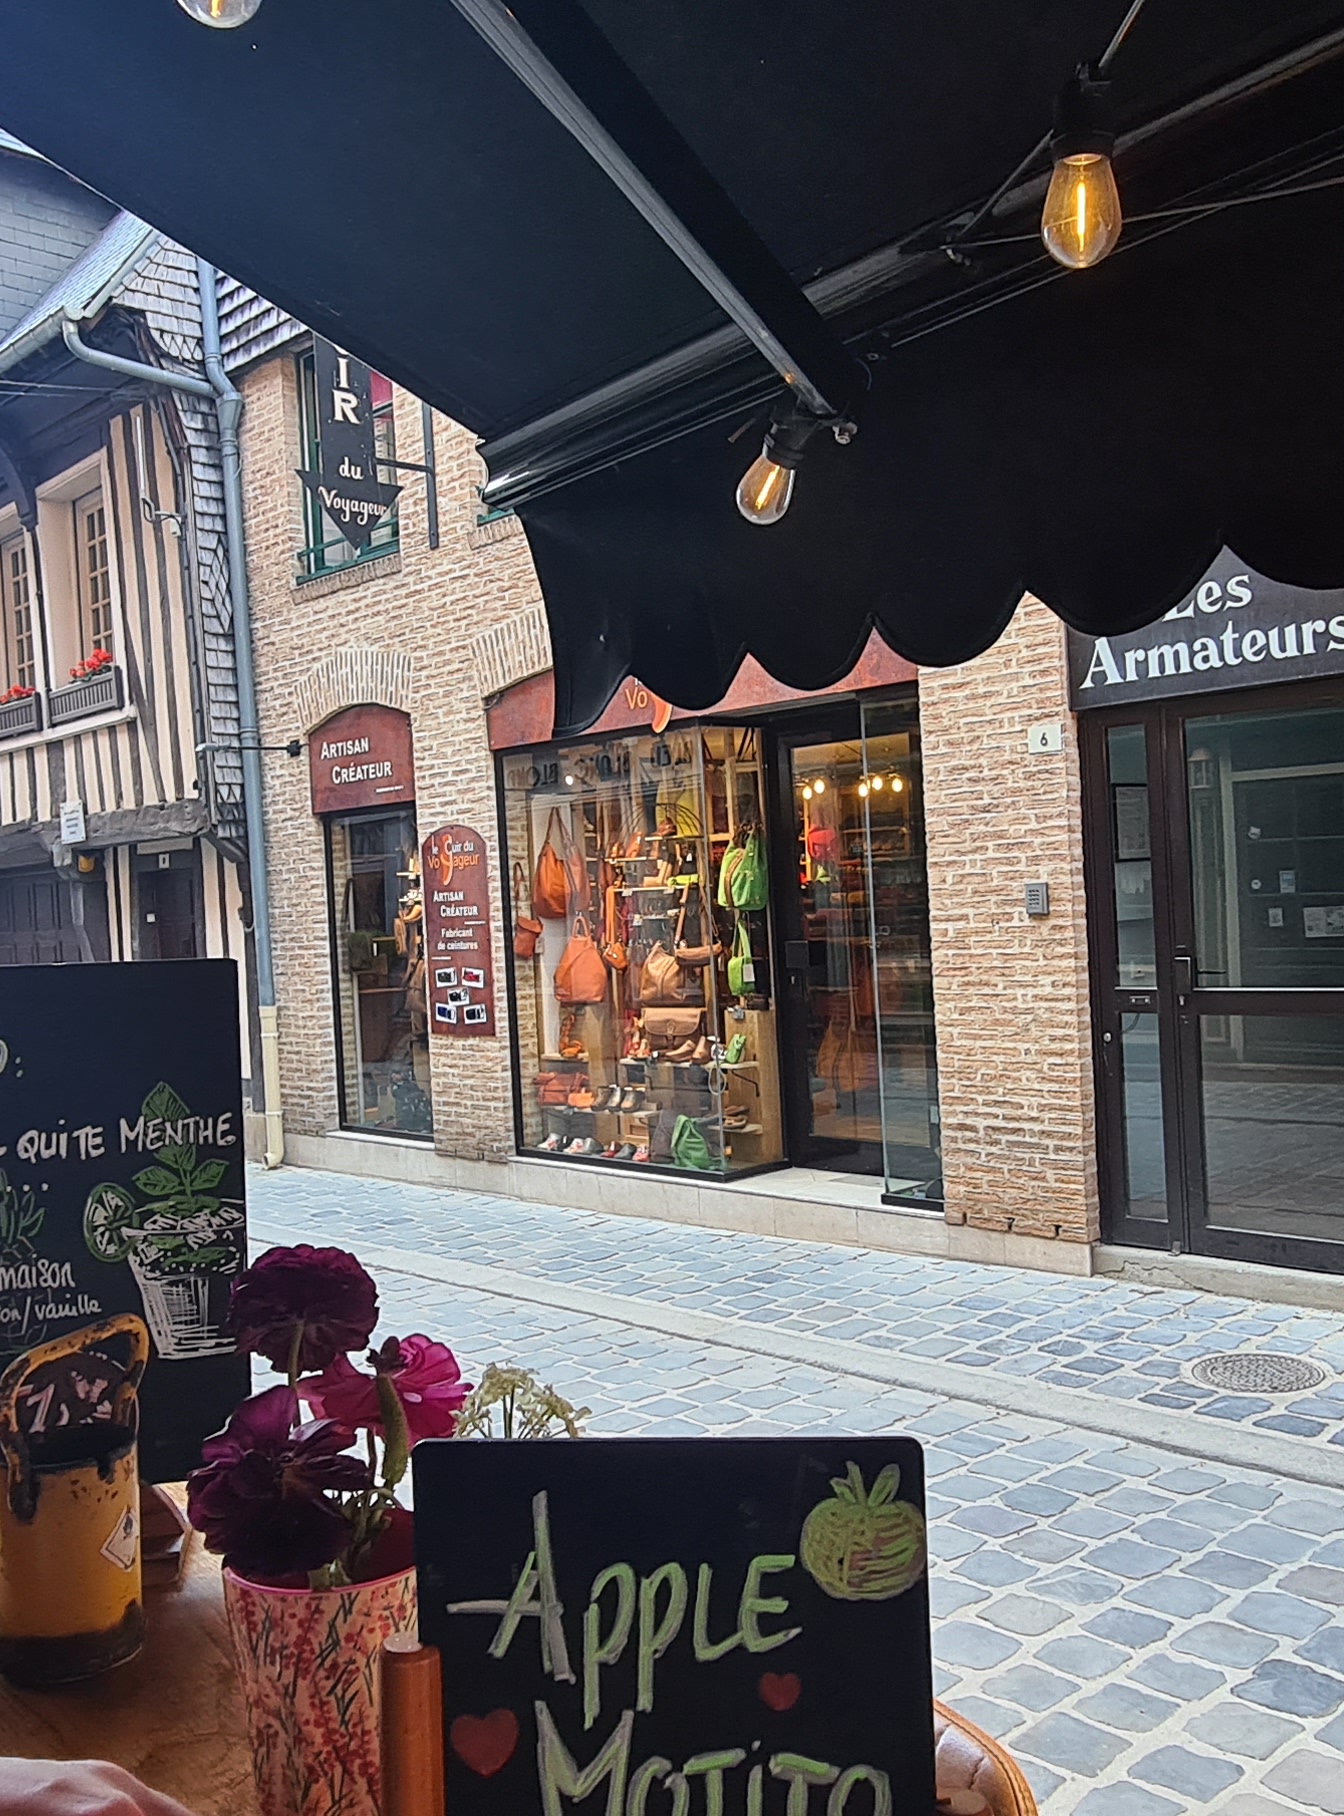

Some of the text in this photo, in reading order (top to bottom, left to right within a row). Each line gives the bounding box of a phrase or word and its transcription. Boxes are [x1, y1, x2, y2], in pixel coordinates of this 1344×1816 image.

[339, 457, 363, 479] du
[318, 486, 386, 525] Voyageur
[1162, 574, 1253, 622] Les
[320, 737, 369, 760] ARTISAN
[1040, 732, 1048, 746] 6
[332, 761, 392, 785] CRÉATEUR
[463, 841, 474, 852] du
[433, 890, 464, 902] ARTISAN
[119, 1112, 236, 1157] MENTHE
[446, 1490, 803, 1730] APPLE
